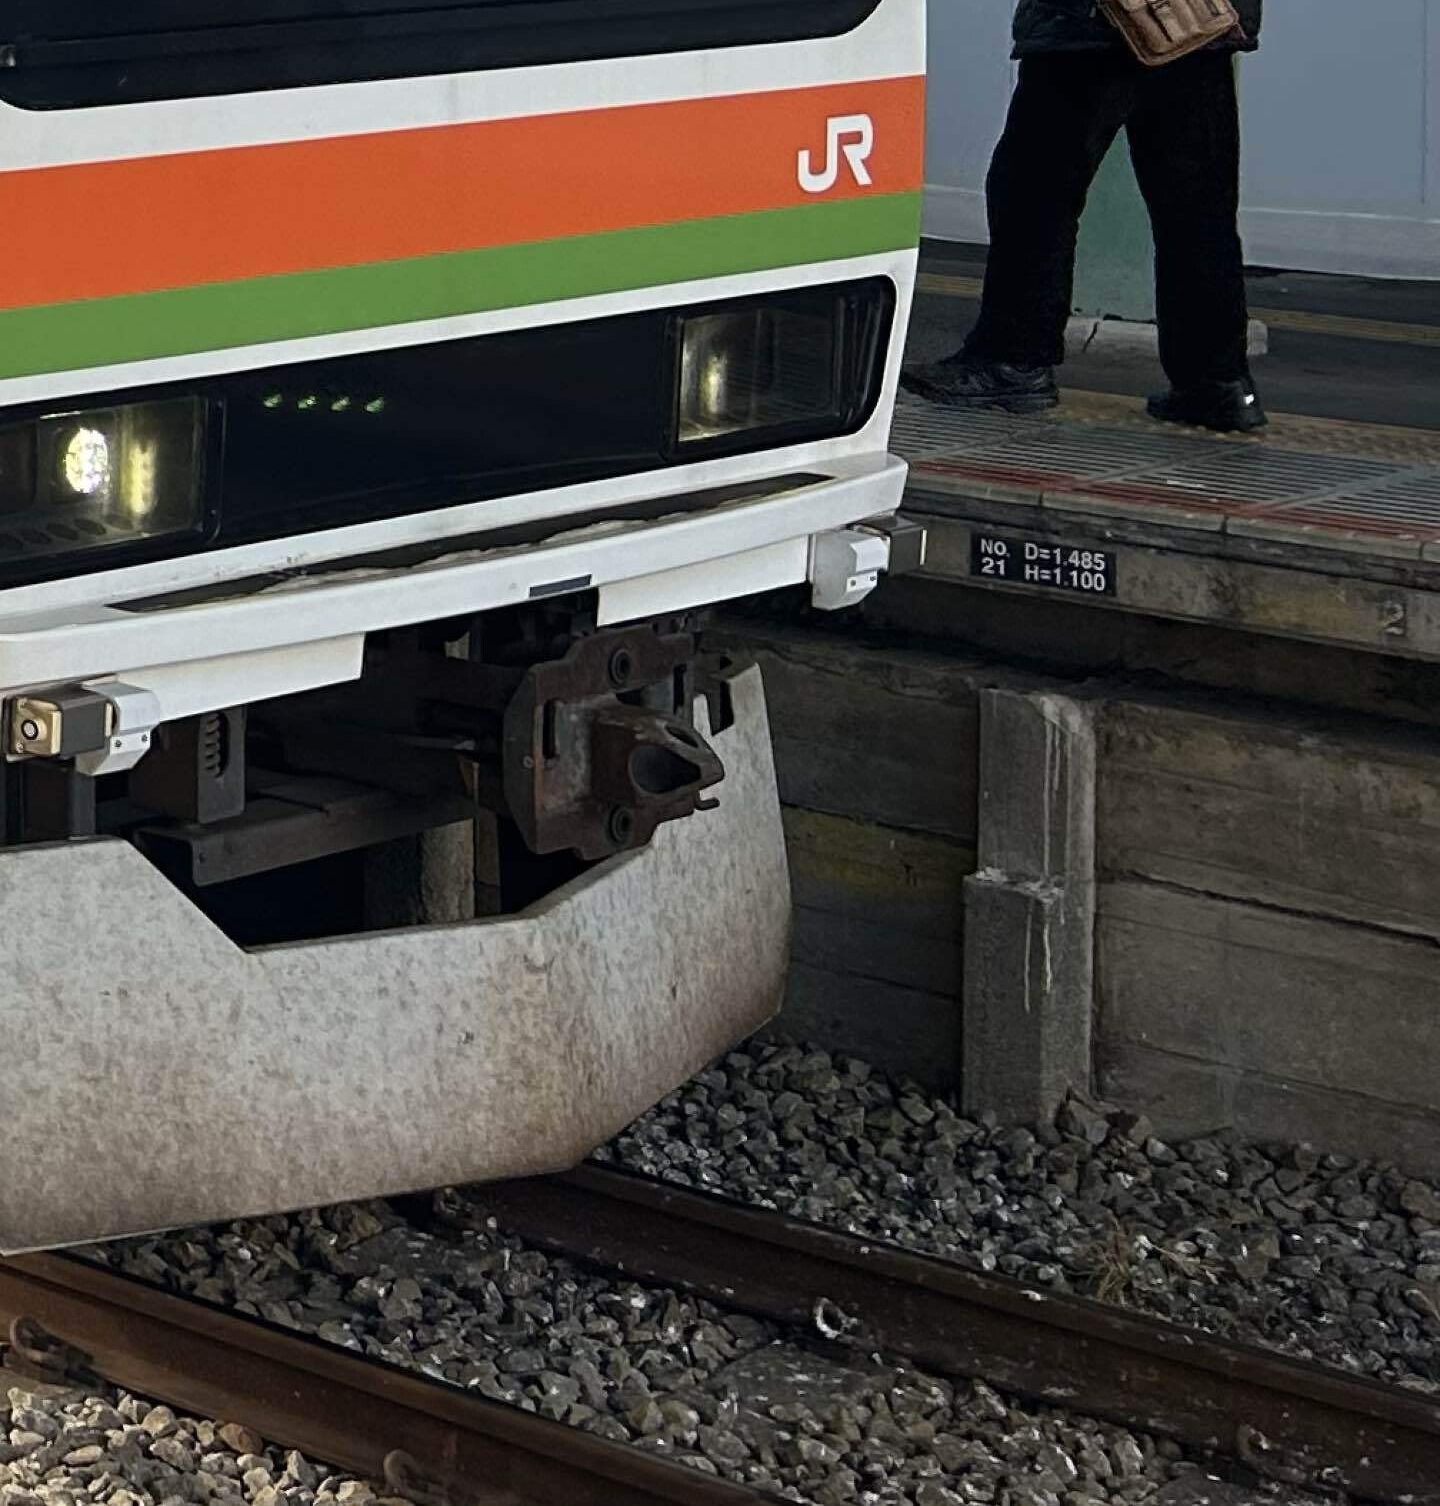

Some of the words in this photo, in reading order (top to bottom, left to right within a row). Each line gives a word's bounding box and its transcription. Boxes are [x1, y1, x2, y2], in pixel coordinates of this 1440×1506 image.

[797, 113, 874, 193] JR
[980, 556, 1006, 576] 21
[1024, 542, 1106, 572] D=1.485
[1024, 564, 1107, 592] H=1.100
